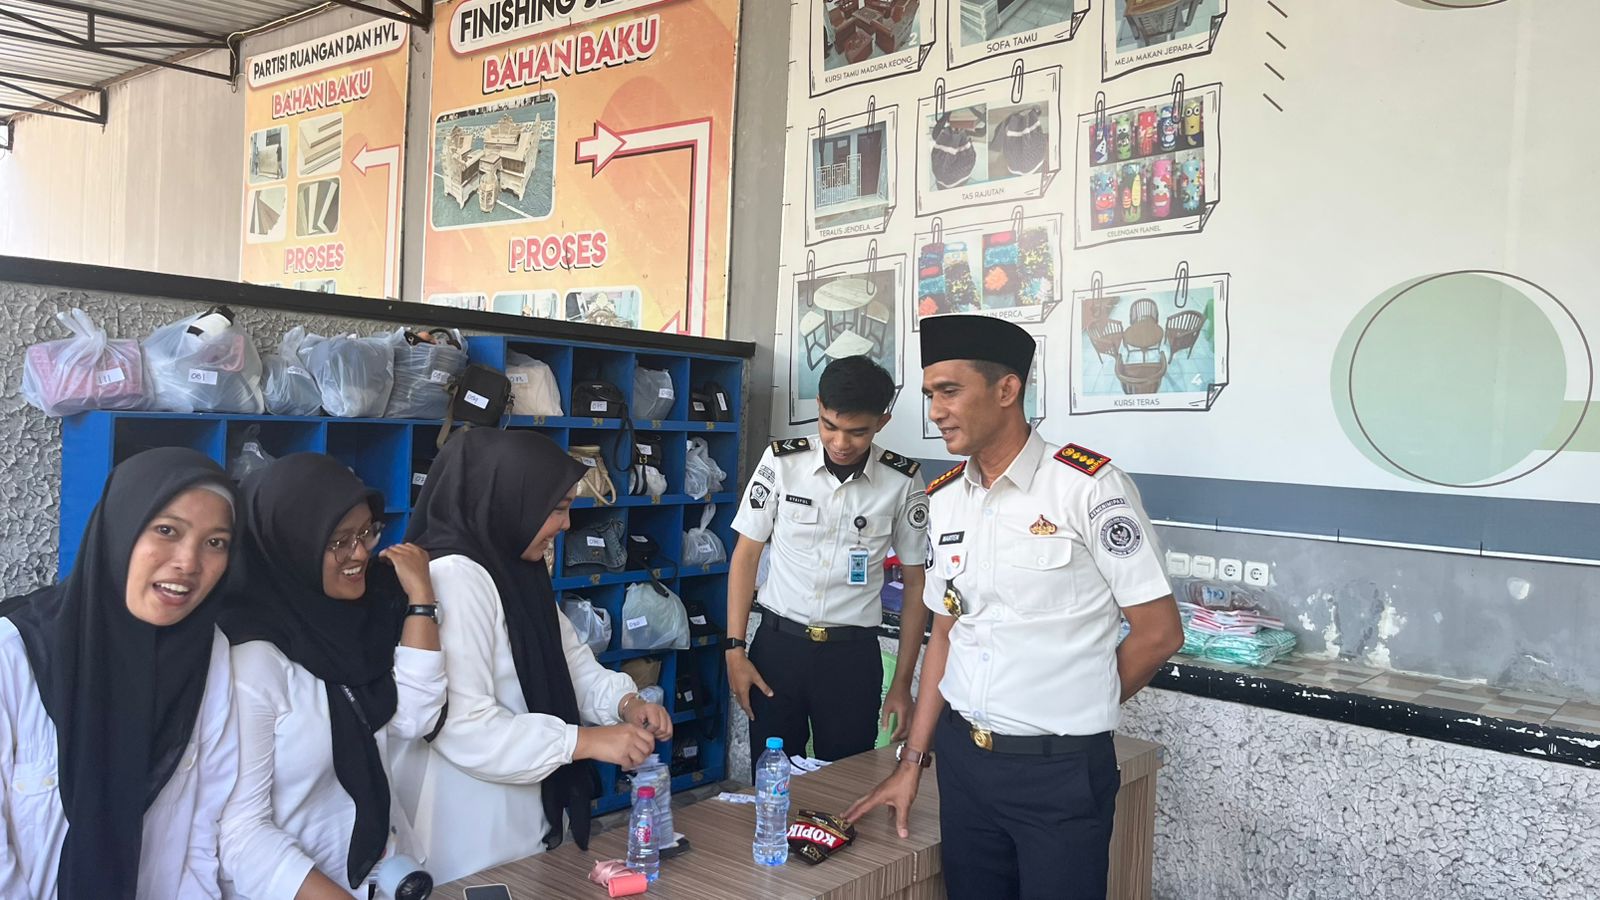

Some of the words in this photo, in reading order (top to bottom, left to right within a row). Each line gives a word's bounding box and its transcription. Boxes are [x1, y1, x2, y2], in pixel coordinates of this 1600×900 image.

[460, 0, 576, 43] FINISHING
[253, 54, 288, 80] PARTISI
[290, 37, 344, 69] RUANGAN
[346, 30, 372, 54] DAN
[374, 22, 399, 47] HVL
[484, 37, 573, 91] BAHAN
[577, 15, 659, 70] BAKU
[986, 39, 1011, 53] SOFA
[1012, 32, 1038, 47] TAMU
[1114, 56, 1134, 66] MEJA
[1135, 50, 1163, 62] MAKAN
[1163, 43, 1193, 56] JEPARA
[824, 72, 842, 84] KURSI
[843, 69, 860, 80] TAMU
[860, 63, 888, 75] MADURA
[888, 55, 913, 68] KEONG
[273, 82, 326, 116] BAHAN
[326, 69, 372, 103] BAKU
[961, 192, 974, 200] TAS
[974, 187, 1005, 198] RAJUTAN
[819, 227, 843, 238] TERALIS
[843, 224, 871, 234] JENDELA
[284, 243, 345, 273] PROSES
[509, 232, 607, 272] PROSES
[999, 310, 1023, 319] PERCA
[1136, 398, 1160, 406] TERAS
[786, 824, 837, 847] KOPIK
